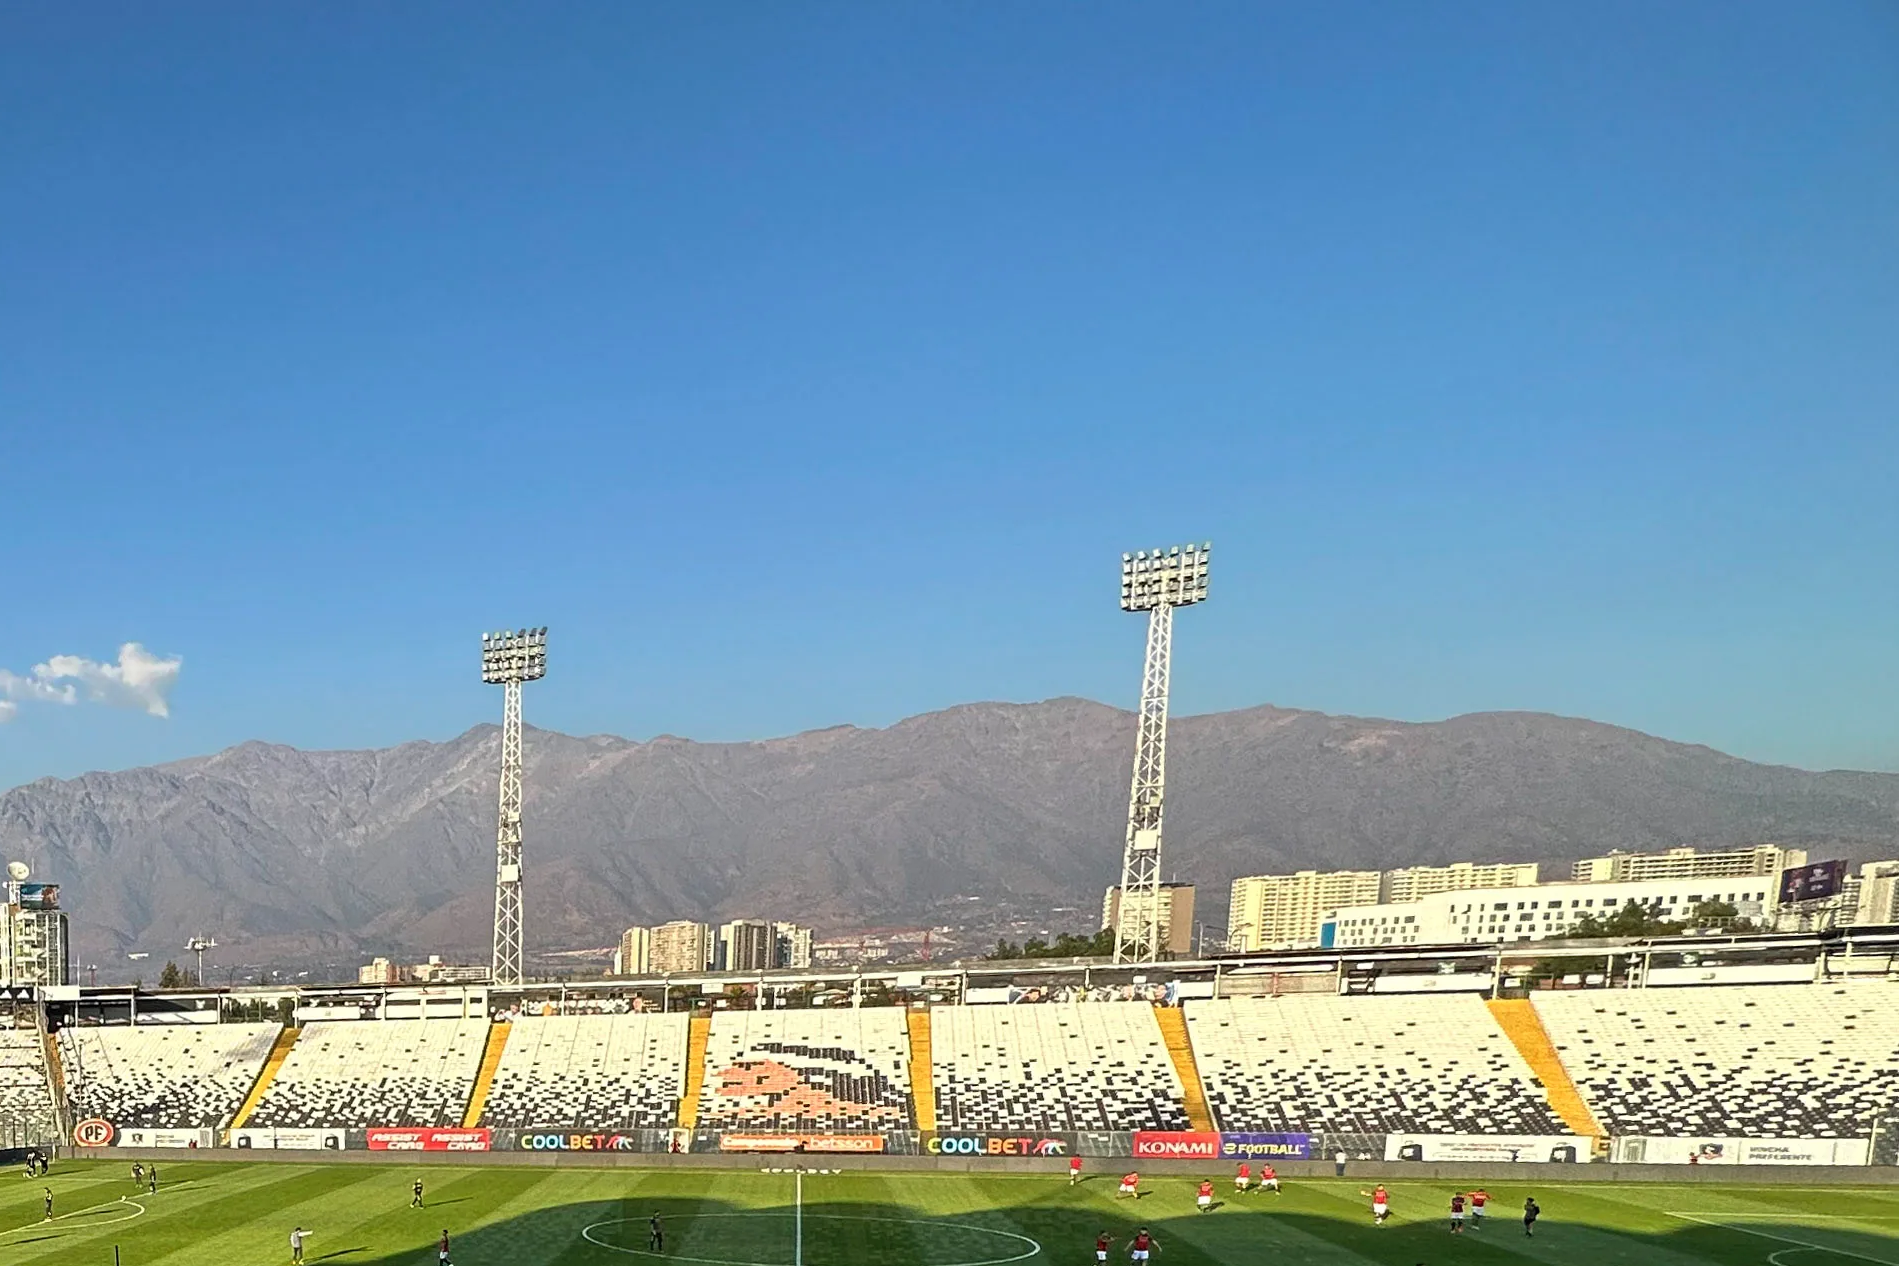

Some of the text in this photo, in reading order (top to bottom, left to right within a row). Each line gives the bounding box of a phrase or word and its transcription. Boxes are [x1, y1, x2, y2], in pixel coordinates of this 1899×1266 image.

[85, 1125, 104, 1140] PF
[520, 1134, 605, 1150] COOLBET
[810, 1137, 873, 1149] betsson
[927, 1137, 1033, 1155] COOLBET
[1138, 1141, 1214, 1155] KONAMI
